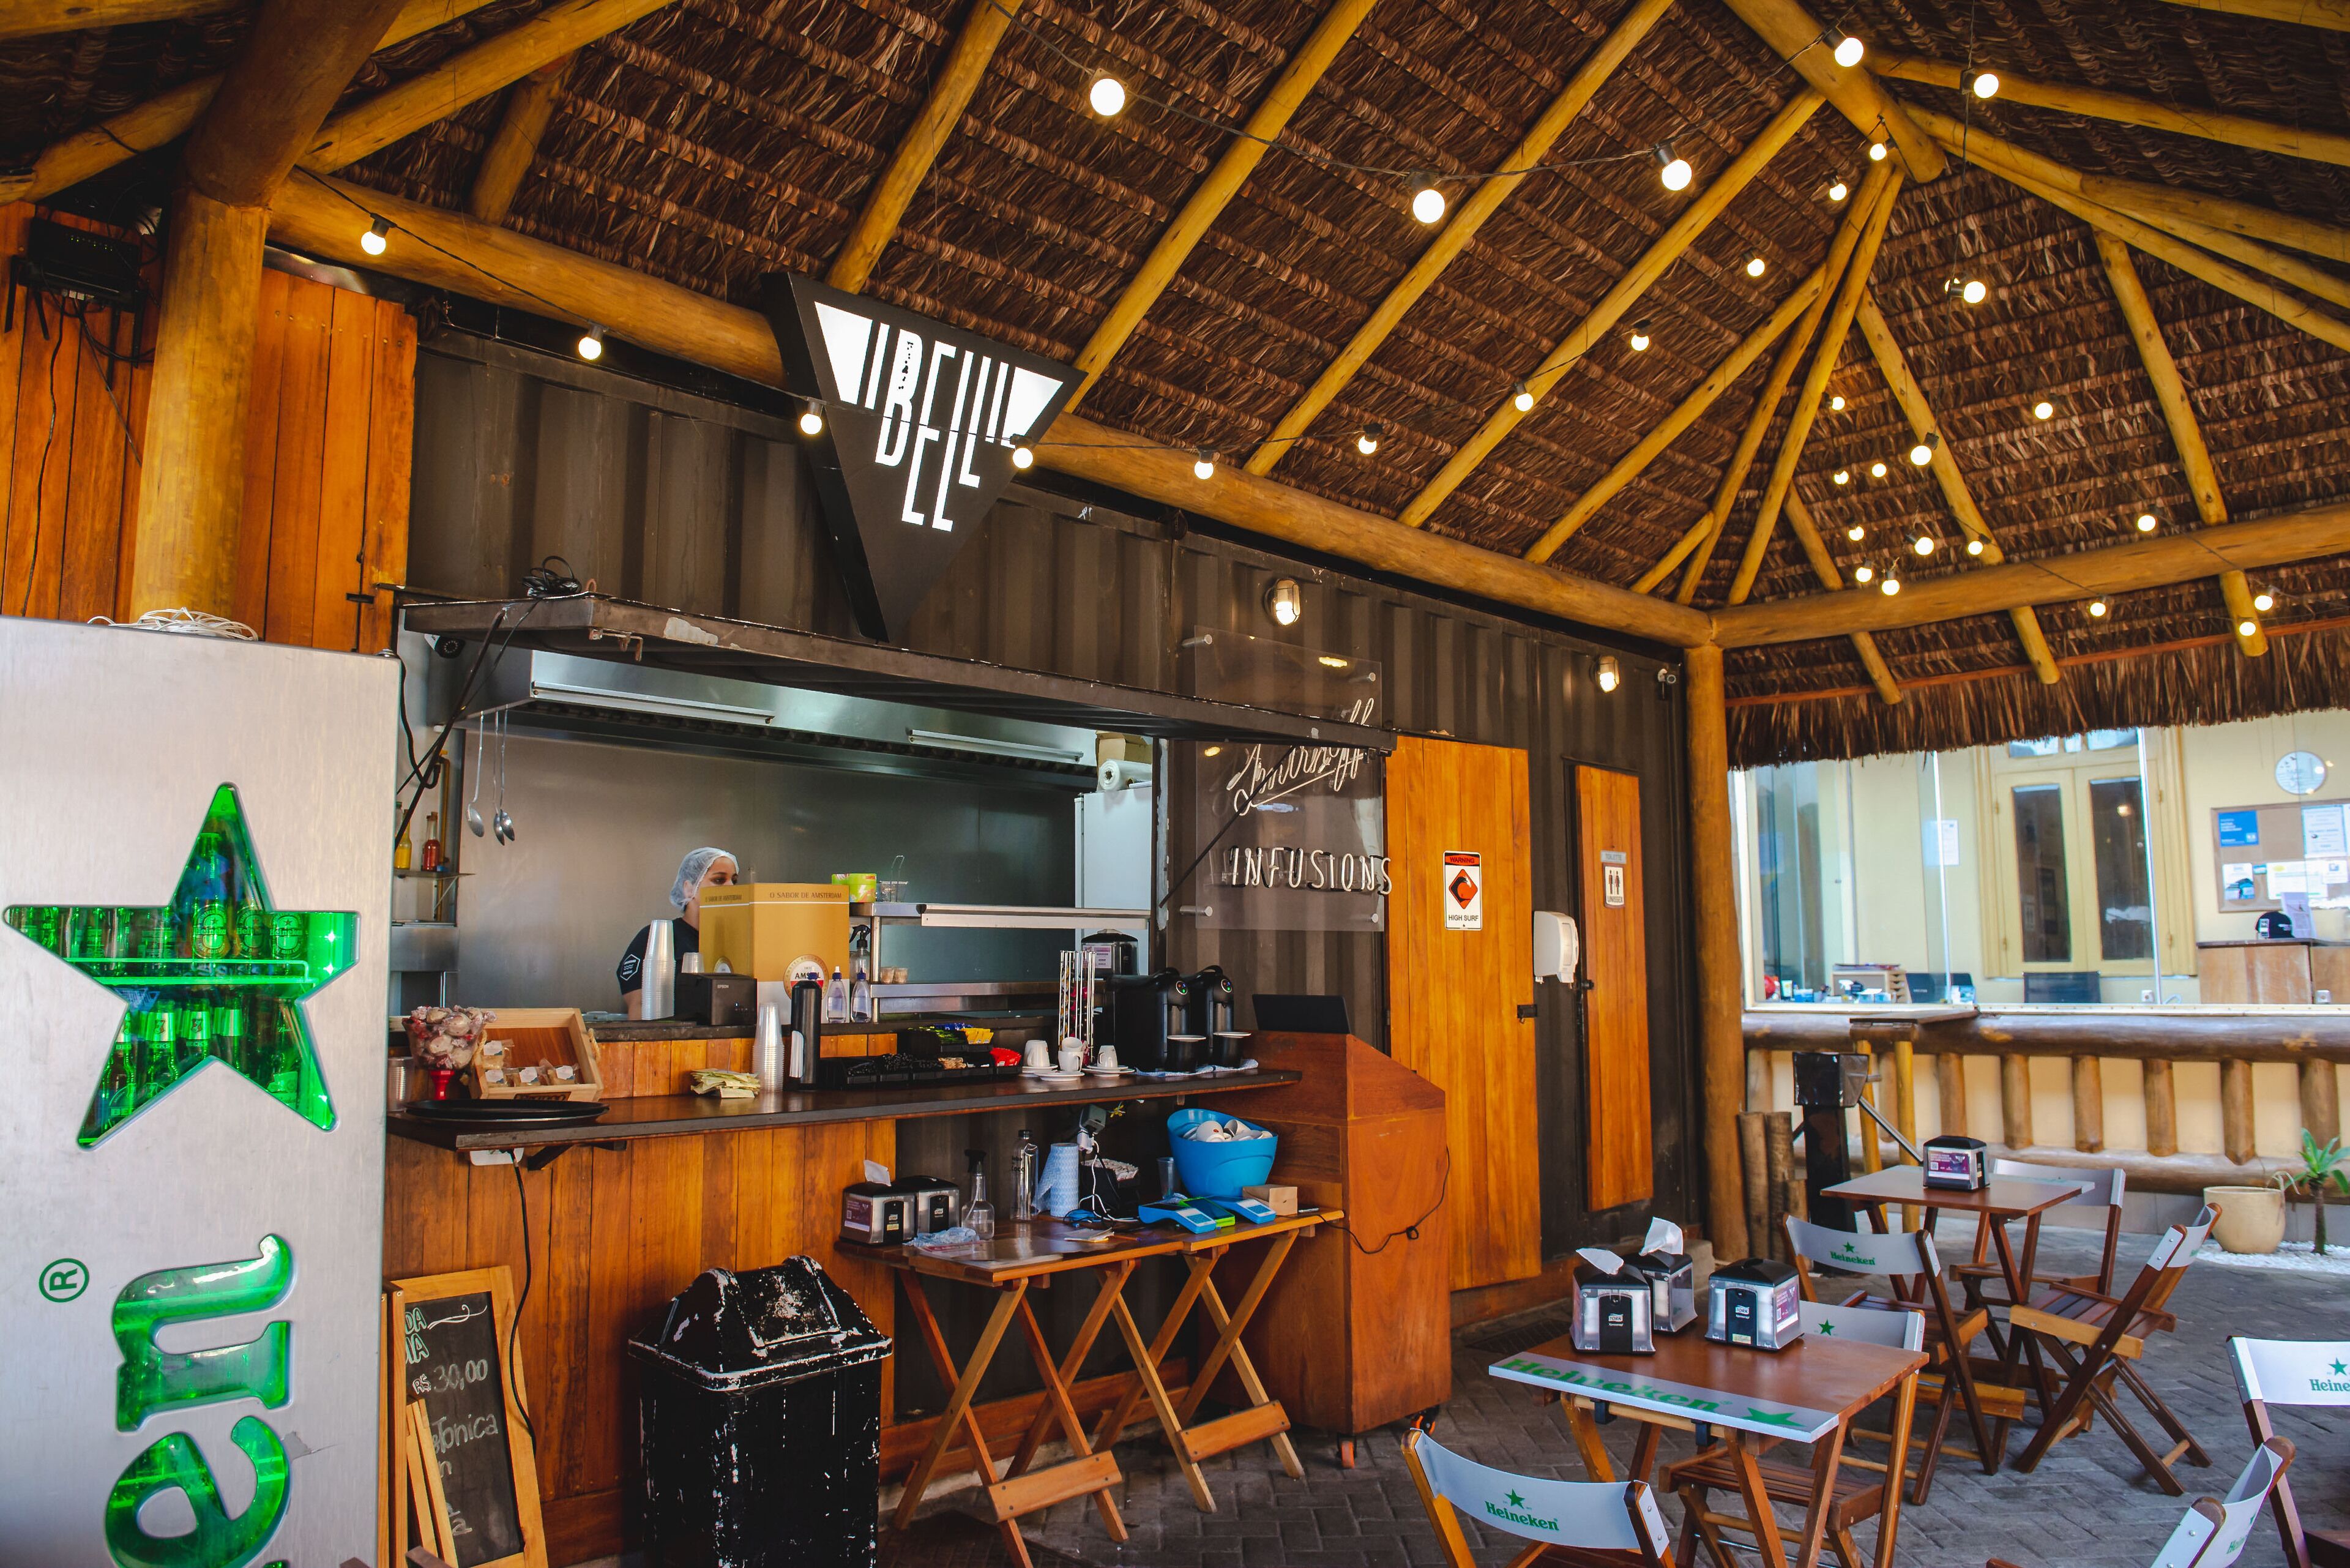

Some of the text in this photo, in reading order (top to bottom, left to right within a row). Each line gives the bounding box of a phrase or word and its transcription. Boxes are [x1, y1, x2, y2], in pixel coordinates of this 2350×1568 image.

[1231, 847, 1392, 895] INFUSIONS
[1830, 1250, 1876, 1266] Heineken
[433, 1358, 488, 1394] 30,00
[1501, 1357, 1721, 1413] Heineken
[1484, 1500, 1560, 1531] Heineken
